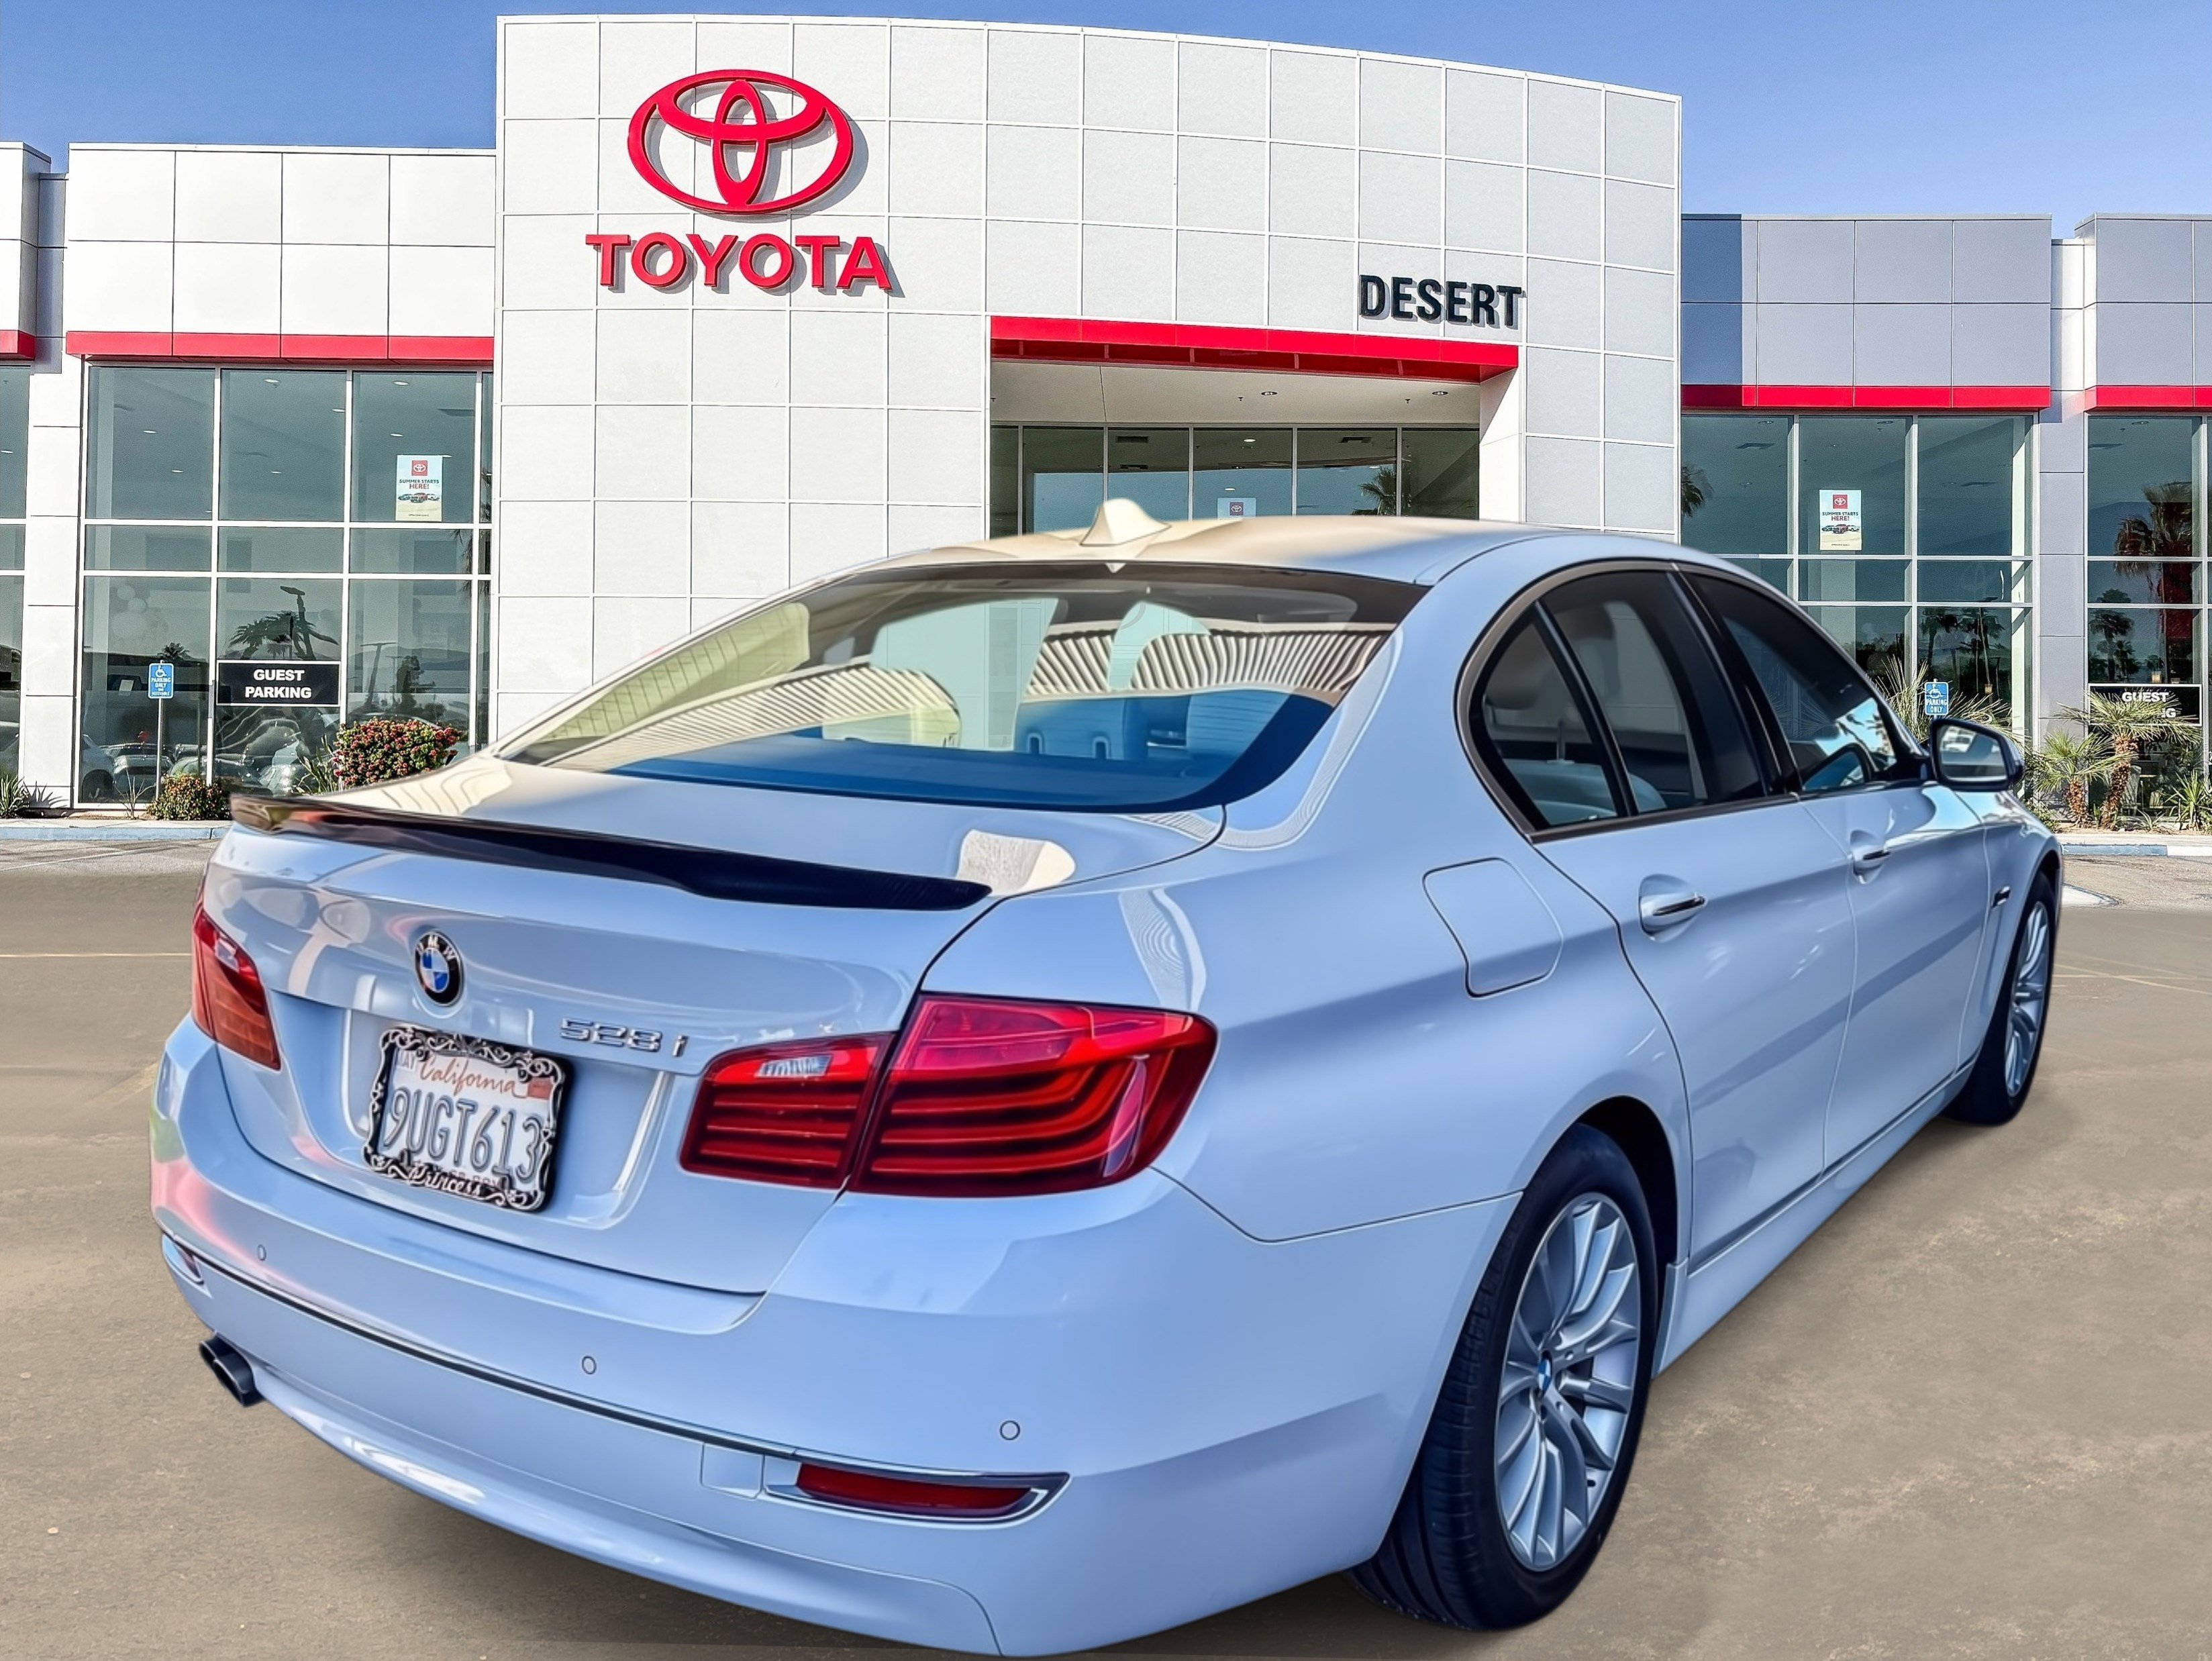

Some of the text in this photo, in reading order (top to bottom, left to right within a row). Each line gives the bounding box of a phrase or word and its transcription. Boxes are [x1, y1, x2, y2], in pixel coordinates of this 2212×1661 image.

[586, 232, 892, 290] TOYOTA
[1359, 274, 1522, 326] DESERT
[245, 686, 311, 699] PARKING
[254, 669, 305, 681] GUEST
[2121, 691, 2169, 703] GUEST
[419, 1054, 527, 1099] California
[383, 1086, 544, 1184] 9UGT613
